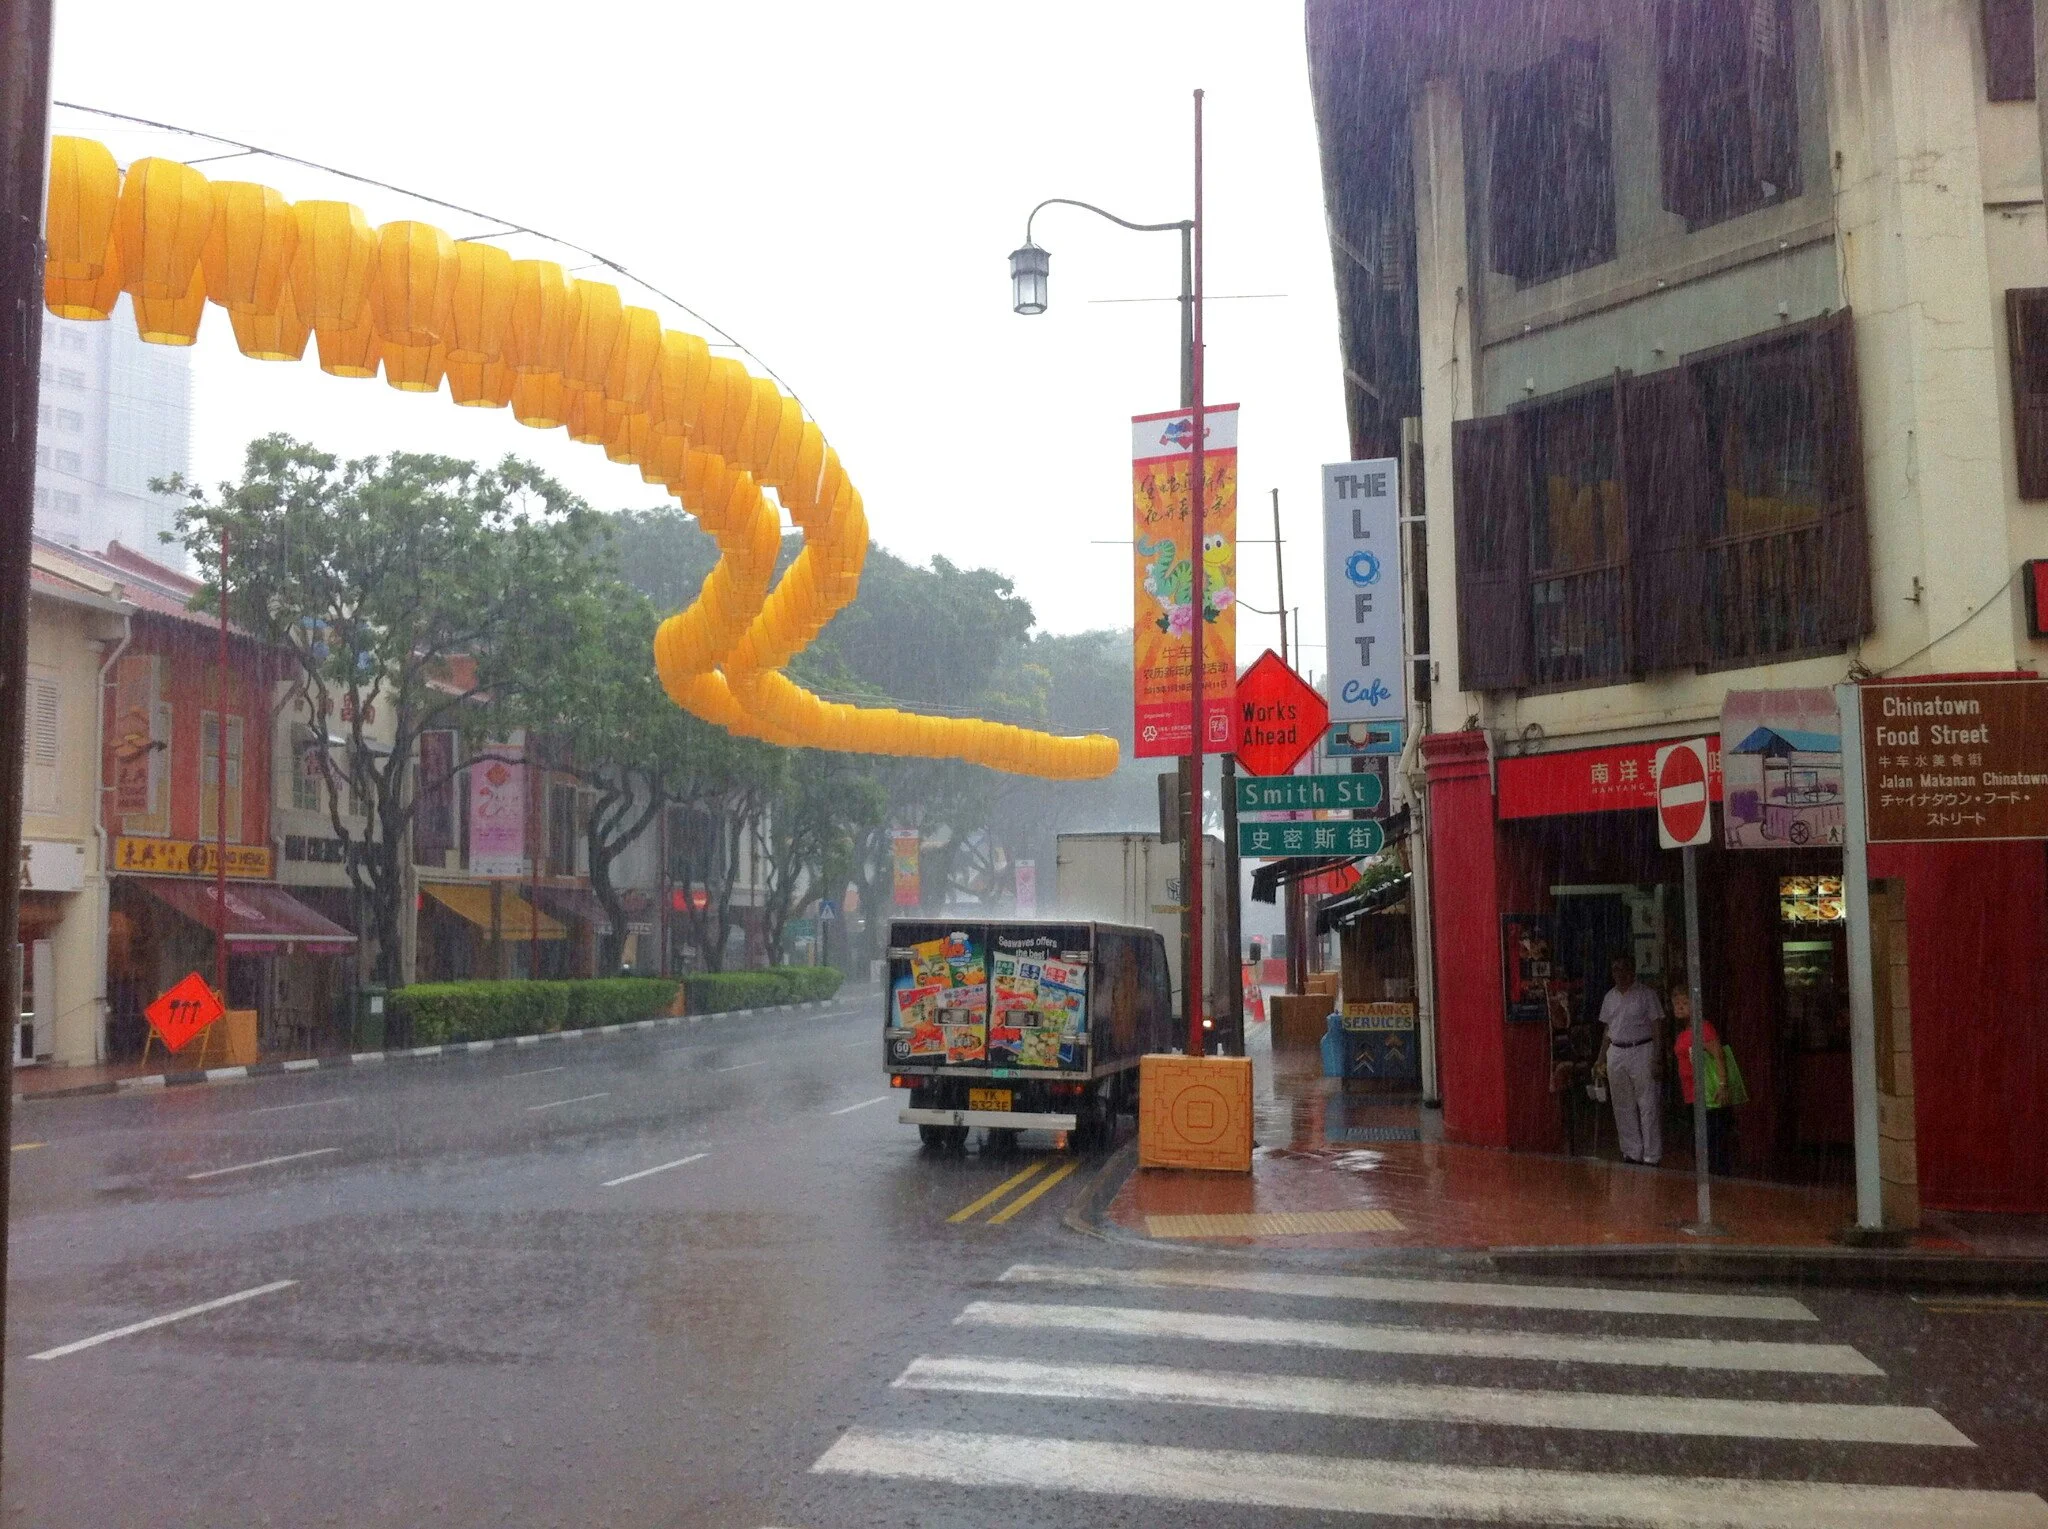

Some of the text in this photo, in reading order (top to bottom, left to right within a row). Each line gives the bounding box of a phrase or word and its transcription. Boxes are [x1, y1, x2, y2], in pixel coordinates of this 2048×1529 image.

[1334, 473, 1386, 499] THE
[1345, 509, 1380, 666] LOFT
[1342, 678, 1391, 707] Cafe
[1243, 702, 1297, 722] Works
[1882, 696, 1980, 717] Chinatown
[1243, 726, 1297, 746] Ahead
[1876, 723, 1989, 746] Food Street
[1878, 753, 1983, 768] 牛车水美食街
[1880, 771, 2048, 789] Jalan Makanan Chinatown
[1246, 781, 1365, 805] Smith St
[1927, 812, 1986, 826] ストリート
[1251, 828, 1372, 850] 史密斯街
[998, 935, 1058, 949] Seawaves offers
[1015, 948, 1028, 958] the
[1348, 1004, 1410, 1016] FRAMING
[896, 1043, 909, 1053] 60
[983, 1090, 997, 1100] YK
